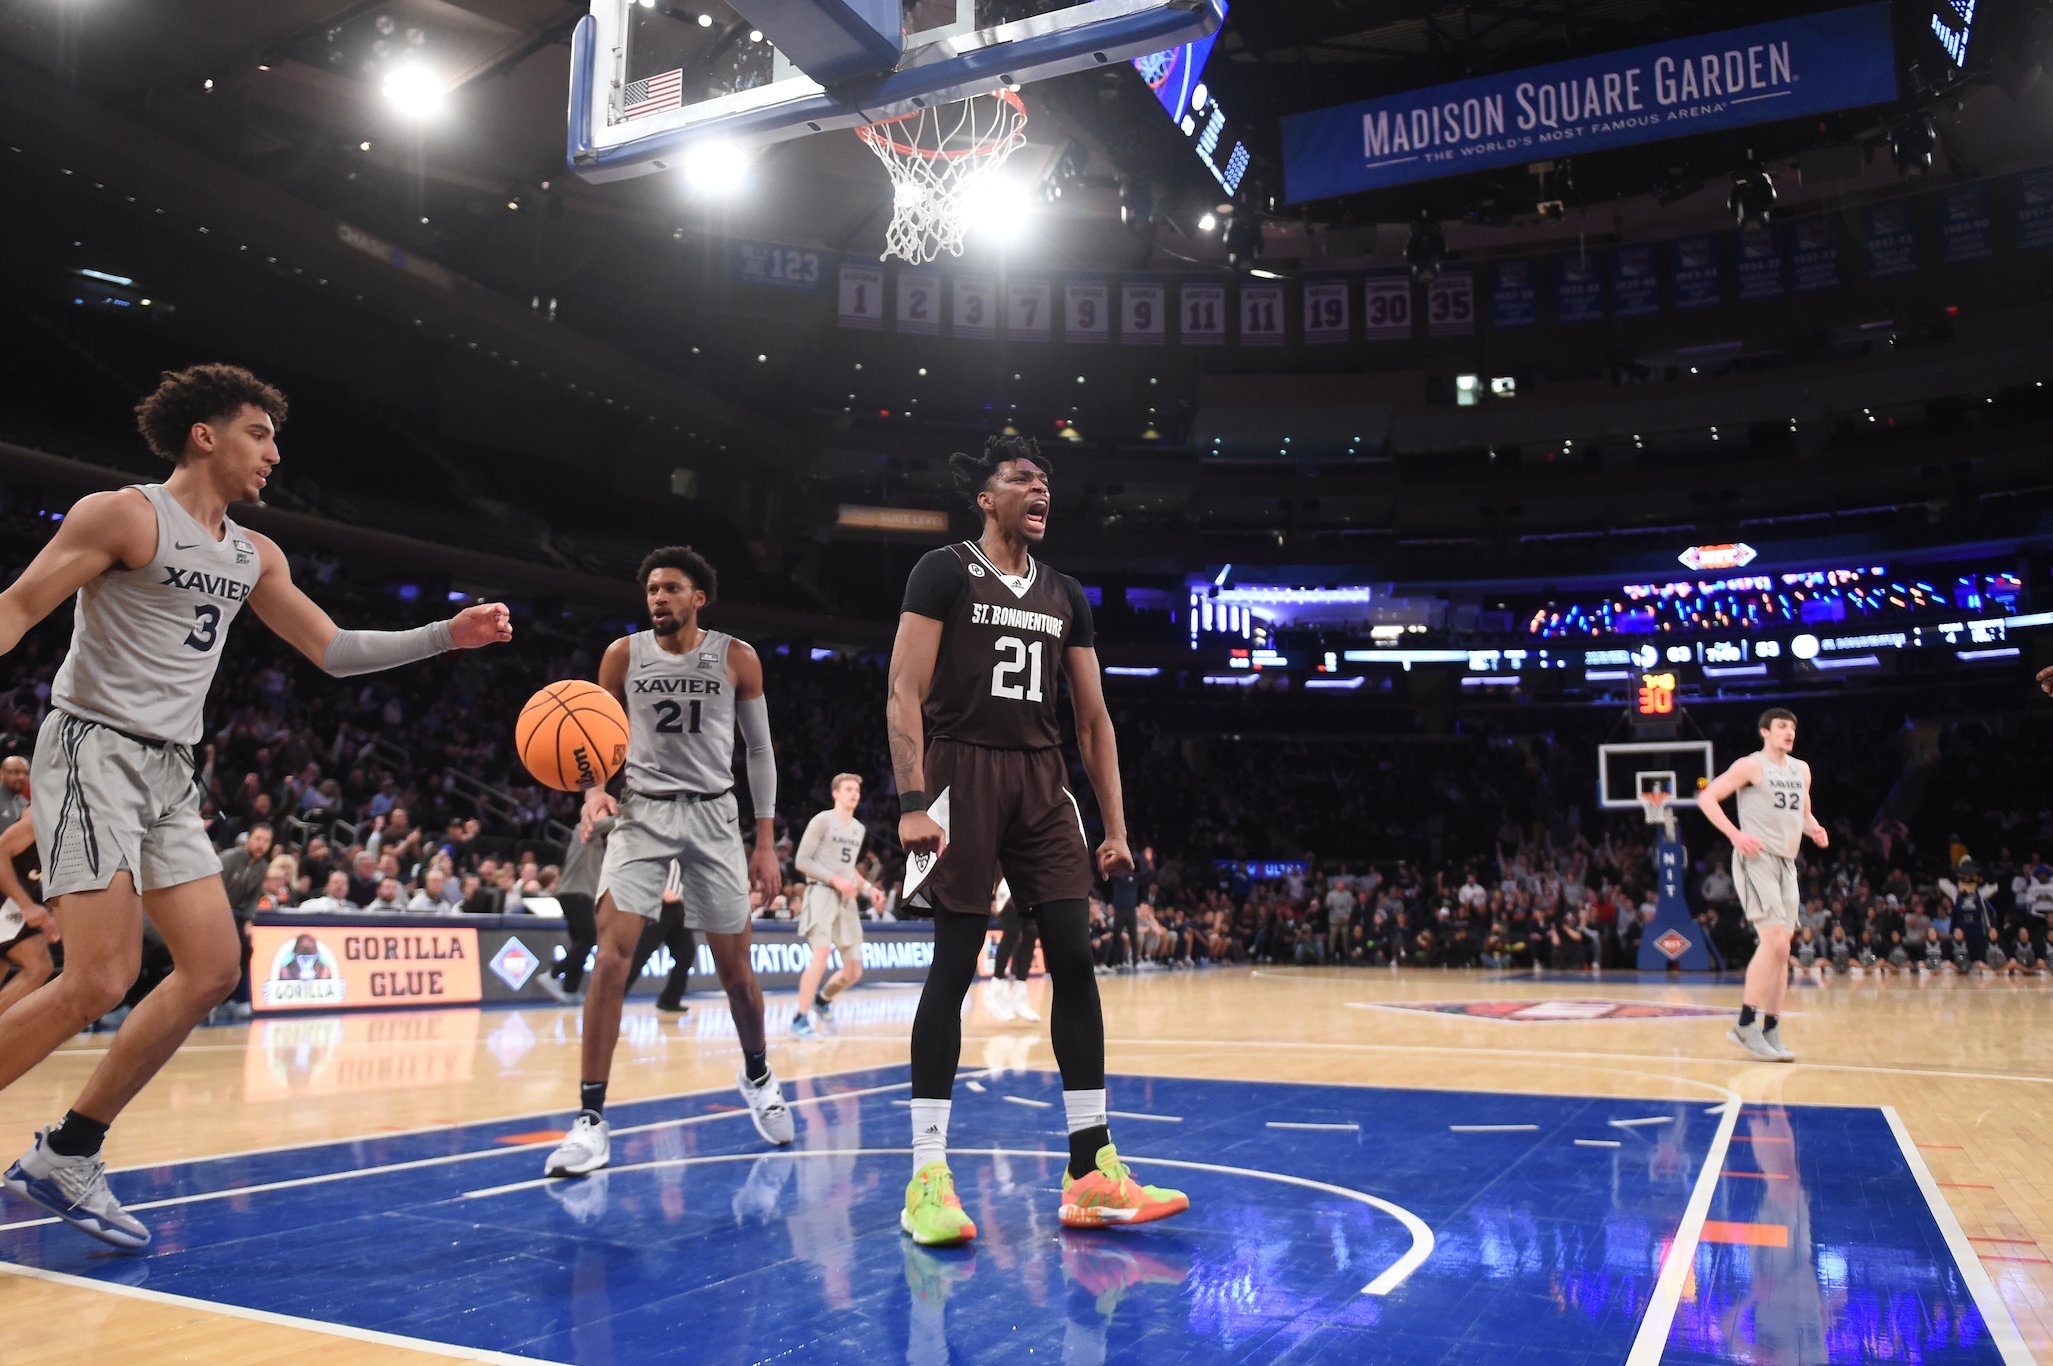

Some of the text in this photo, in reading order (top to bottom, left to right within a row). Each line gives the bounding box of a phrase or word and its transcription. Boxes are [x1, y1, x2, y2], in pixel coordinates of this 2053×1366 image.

[1363, 41, 1792, 157] MADISON SQUARE GARDEN
[1423, 103, 1725, 163] THE WORLD'S MOST FAMOUS ARENA
[771, 249, 819, 282] 123
[853, 284, 868, 314] 1
[909, 289, 928, 319] 2
[965, 295, 983, 324] 3
[1020, 298, 1038, 327] 7
[1077, 299, 1095, 328] 9
[1310, 299, 1343, 328] 19
[1370, 295, 1407, 325] 30
[1432, 291, 1471, 320] 35
[1134, 301, 1152, 330] 9
[1189, 301, 1215, 330] 11
[1249, 302, 1275, 331] 11
[160, 566, 250, 602] XAVIER
[183, 604, 221, 652] 3
[971, 603, 1064, 639] ST. BONAVENTURE
[991, 636, 1043, 703] 21
[634, 679, 721, 695] XAVIER
[1639, 687, 1673, 714] 30
[652, 699, 702, 734] 21
[1774, 791, 1800, 810] 32
[841, 847, 852, 864] 5
[345, 936, 465, 961] GORILLA
[274, 983, 335, 1000] GORILLA
[370, 971, 444, 997] GLUE
